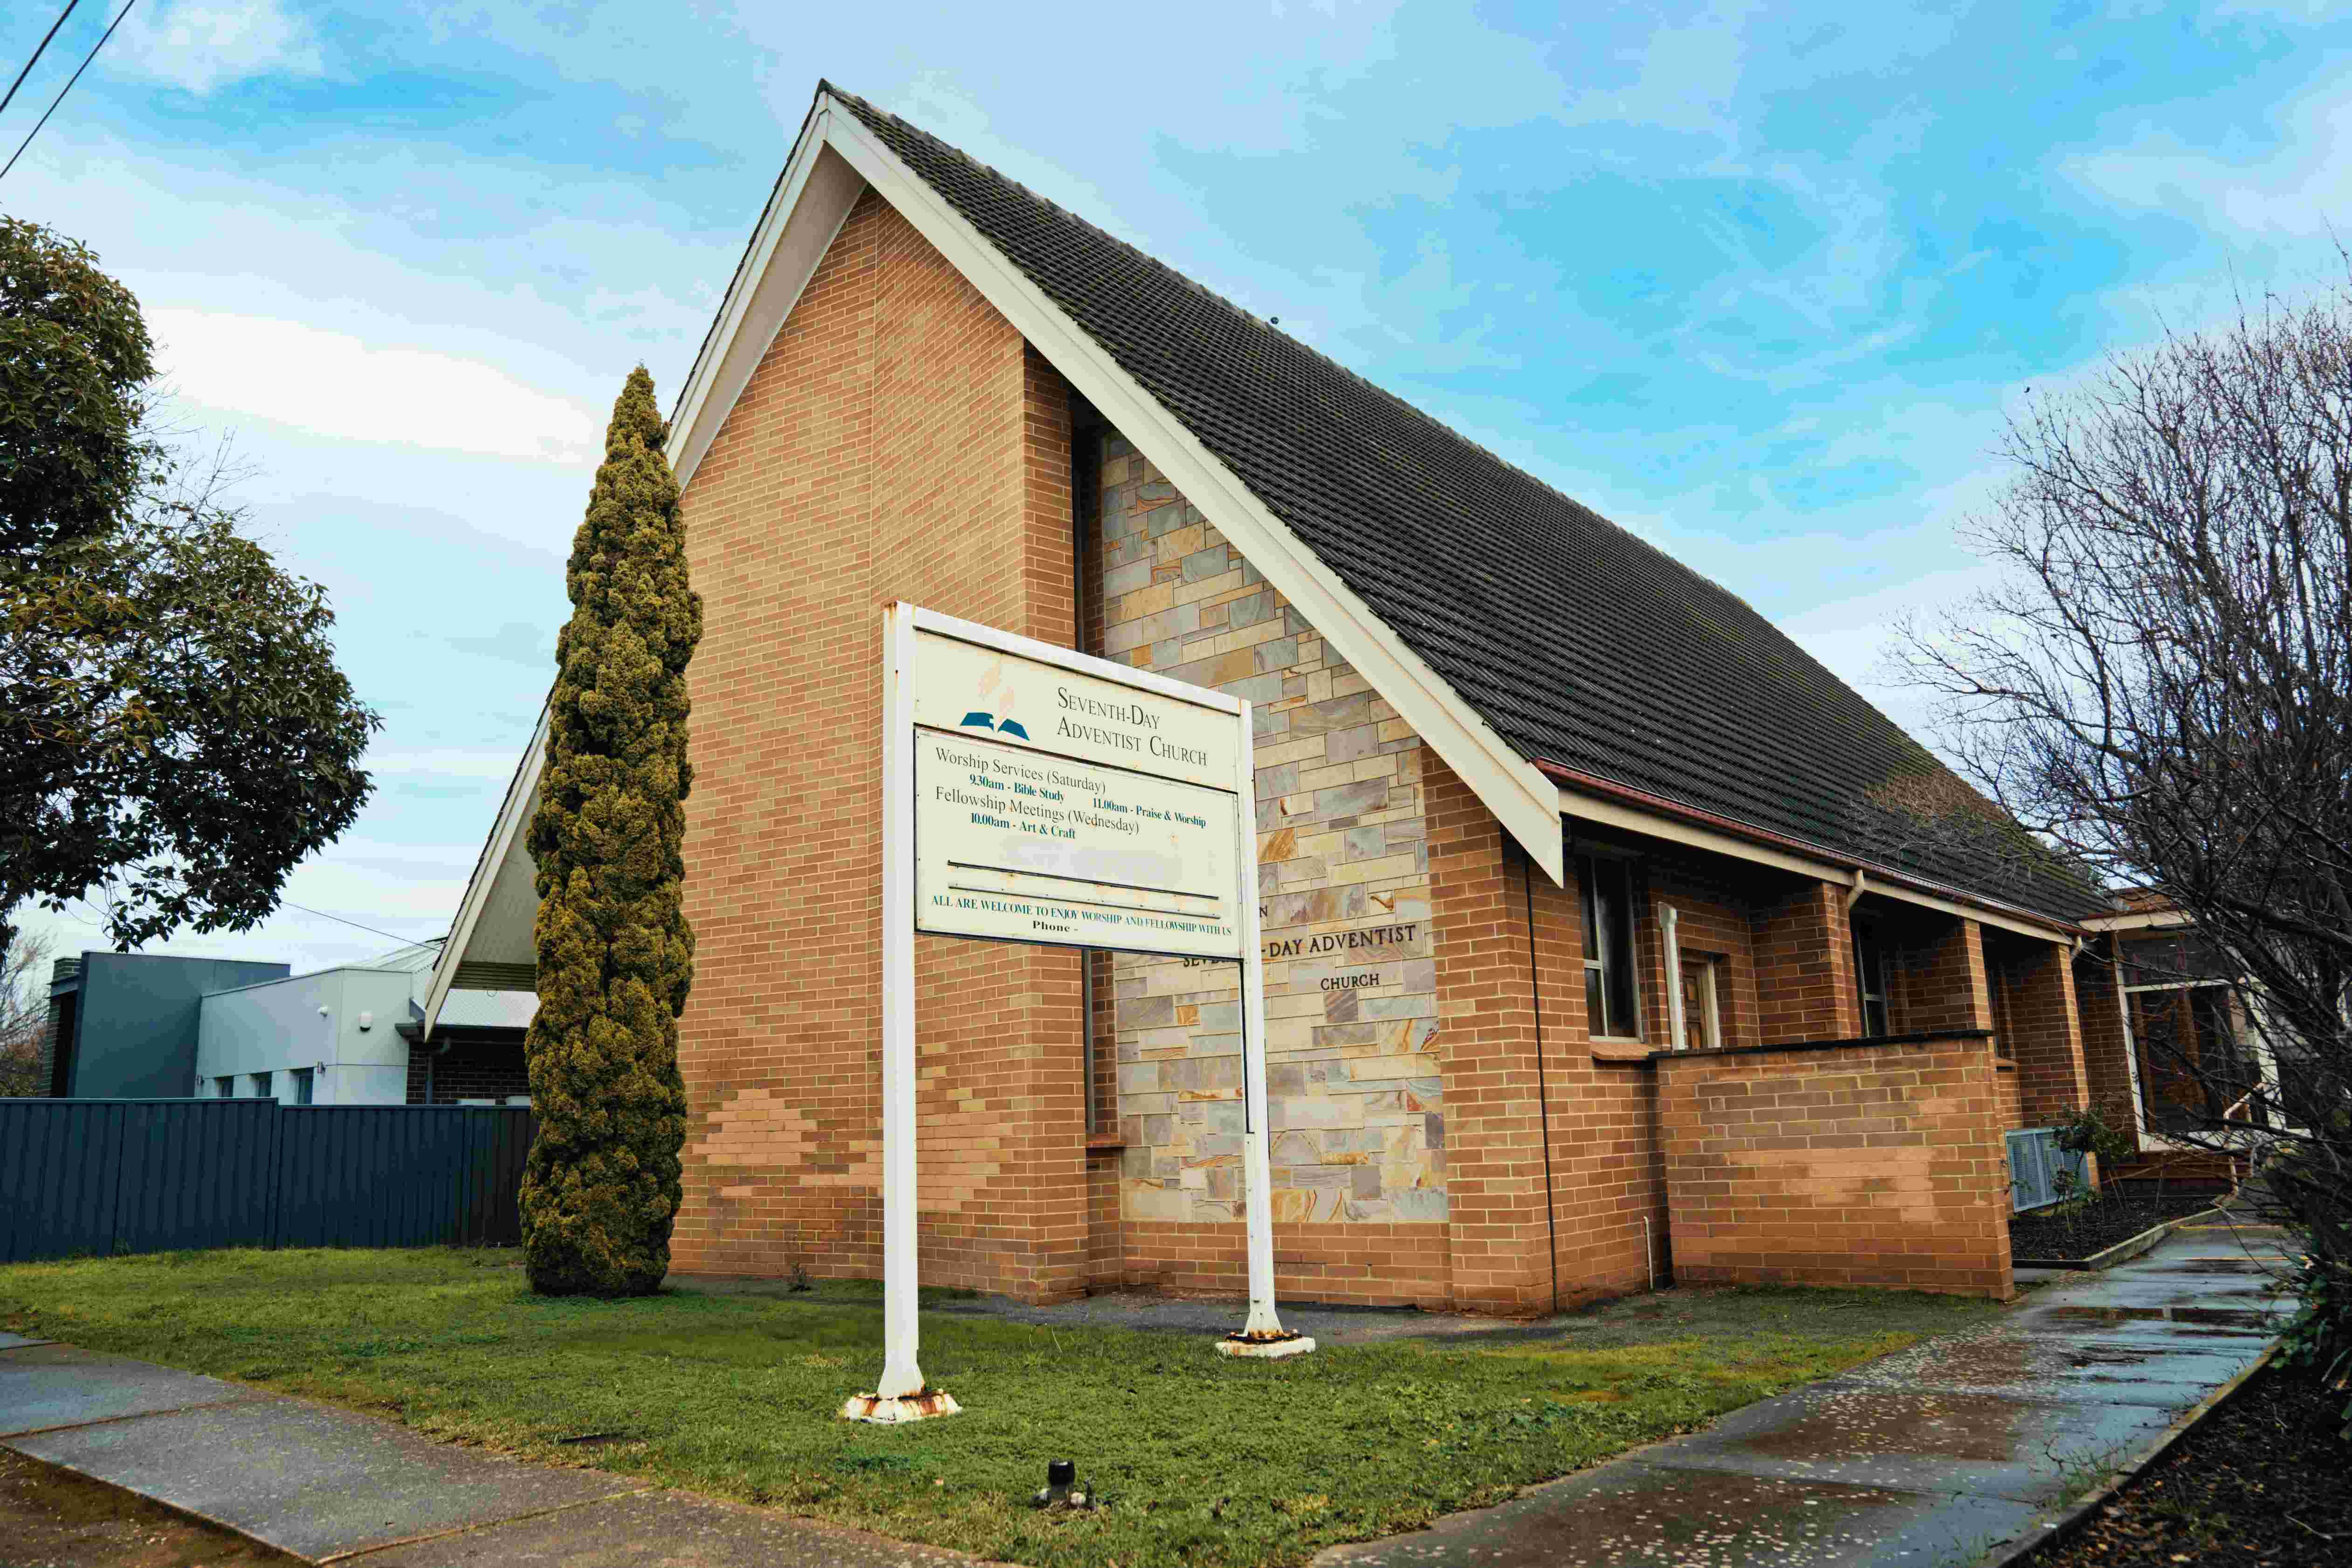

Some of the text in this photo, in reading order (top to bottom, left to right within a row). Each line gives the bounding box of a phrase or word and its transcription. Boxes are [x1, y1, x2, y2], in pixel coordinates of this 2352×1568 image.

[1058, 687, 1160, 729] SEVENTH-DAY
[1057, 715, 1207, 766] ADVENTIST CHURCH
[935, 747, 1106, 794] Worship Services (Saturday)
[969, 773, 1004, 791] 9.30am
[1014, 782, 1037, 796] Bible
[1039, 787, 1065, 804] Study
[935, 786, 1139, 835] Fellowship Meetings (Wednesday)
[970, 812, 1010, 829] 10.00am
[1019, 820, 1037, 833] Art
[1039, 824, 1048, 835] &
[1051, 825, 1075, 839] Craft
[1093, 798, 1128, 813] 11.00am
[1136, 805, 1162, 820] Praise
[1164, 811, 1171, 821] &
[1174, 812, 1206, 829] Worship
[931, 895, 1231, 935] ALL ARE WELCOME TO ENJOY WORSHIP AND FELLOWSHIP WITH US
[1032, 920, 1070, 932] Phone
[1309, 924, 1416, 953] ADVENTIST
[1320, 973, 1380, 990] CHURCH
